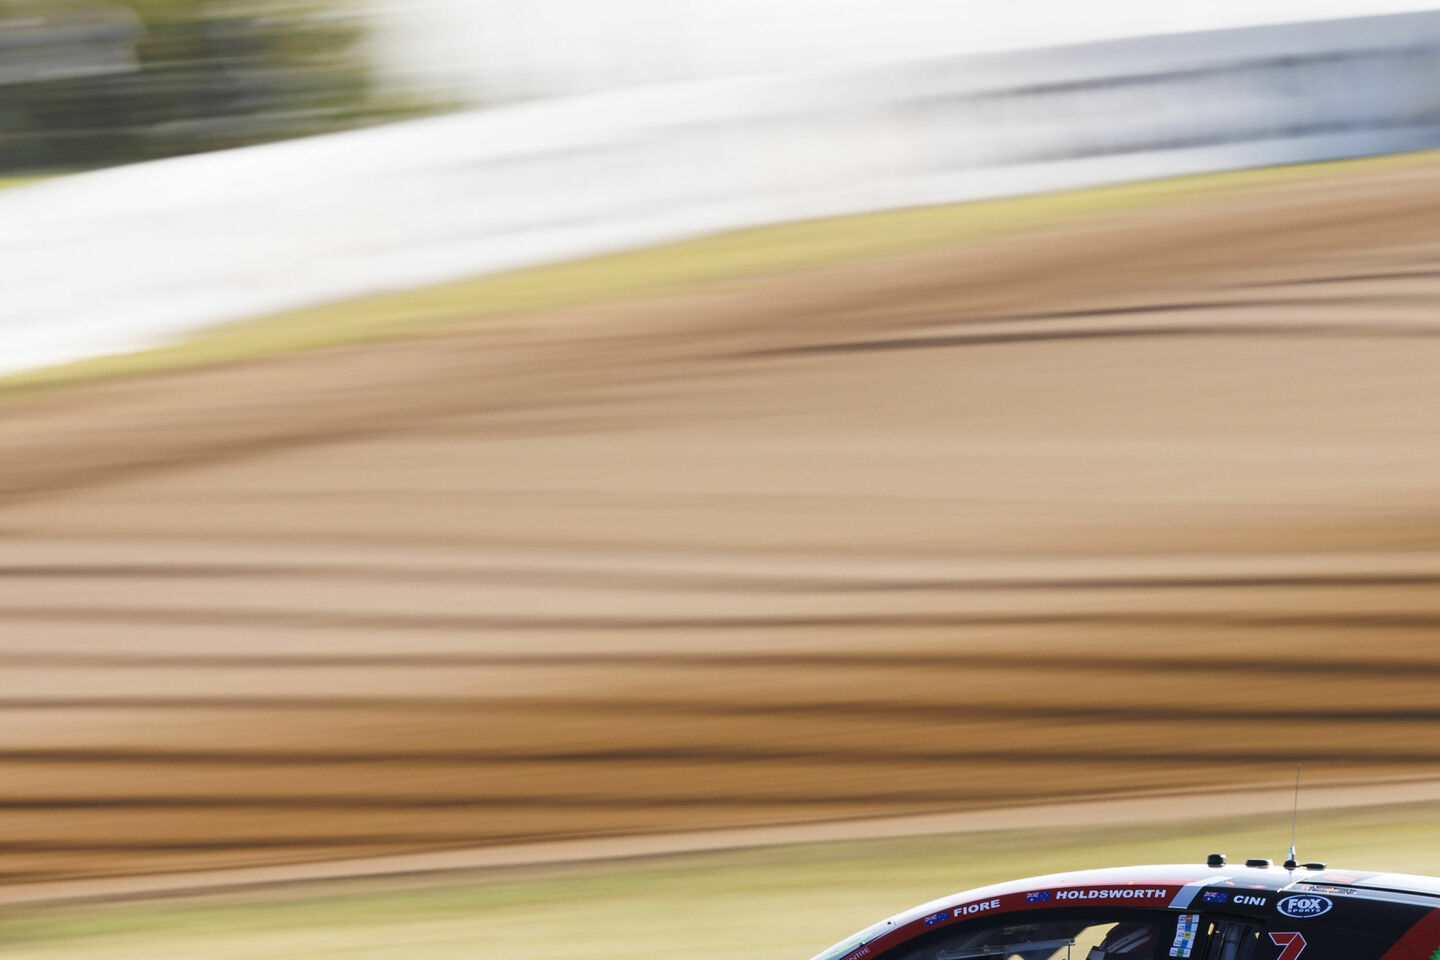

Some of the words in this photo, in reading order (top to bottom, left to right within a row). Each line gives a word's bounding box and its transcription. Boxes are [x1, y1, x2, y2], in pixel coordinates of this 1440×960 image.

[1055, 889, 1167, 900] HOLDSWORTH
[1233, 895, 1267, 906] CINI
[1288, 898, 1322, 909] FOX
[953, 899, 1001, 917] FIORE
